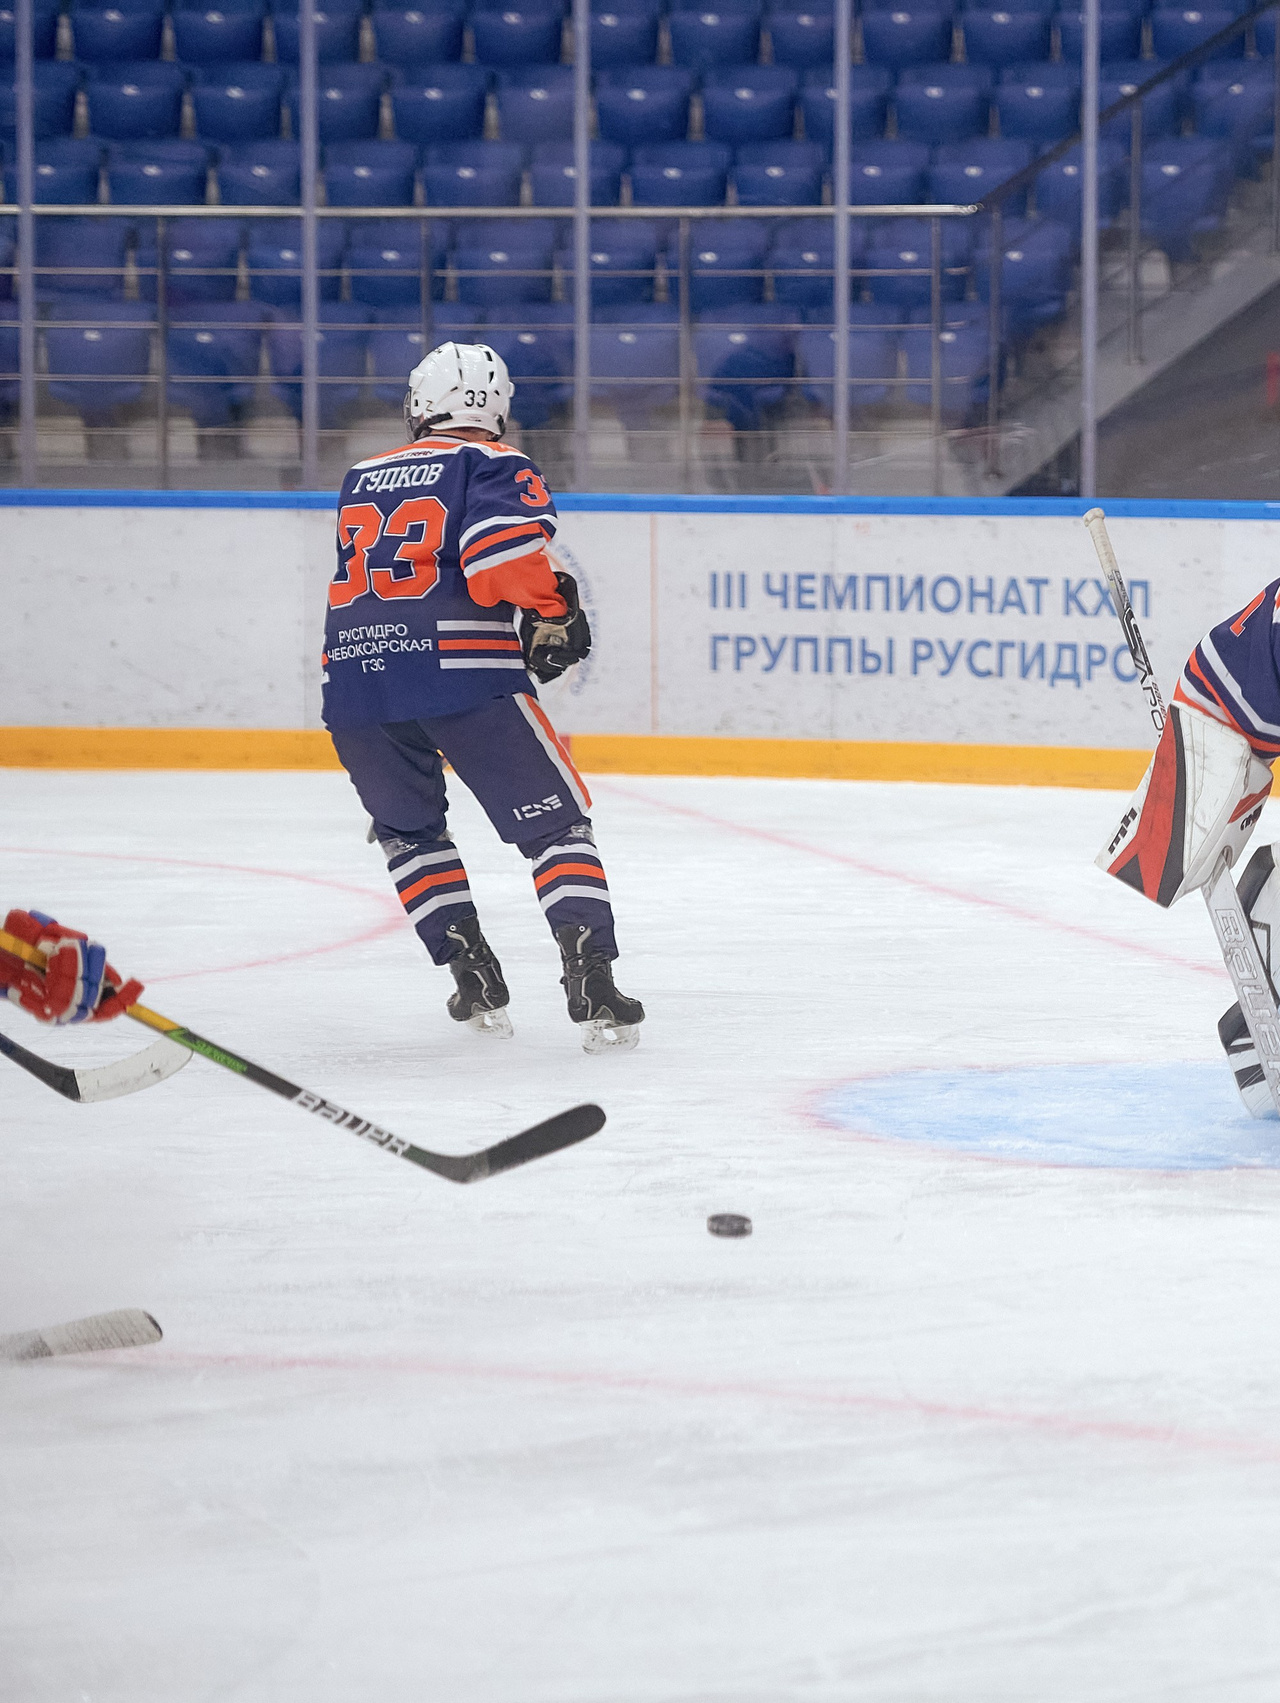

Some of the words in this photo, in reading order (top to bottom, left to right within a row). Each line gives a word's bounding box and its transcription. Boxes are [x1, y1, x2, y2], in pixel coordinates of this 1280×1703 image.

[464, 389, 487, 408] 33
[351, 463, 444, 493] ГУДКОВ
[328, 496, 449, 609] 33
[764, 573, 1048, 616] ЧЕМПИОНАТ
[327, 638, 434, 662] ЧЕБОКСАРСКАЯ
[338, 623, 408, 643] РУСГИДРО
[709, 635, 894, 675] ГРУППЫ
[292, 1088, 411, 1157] BAUER
